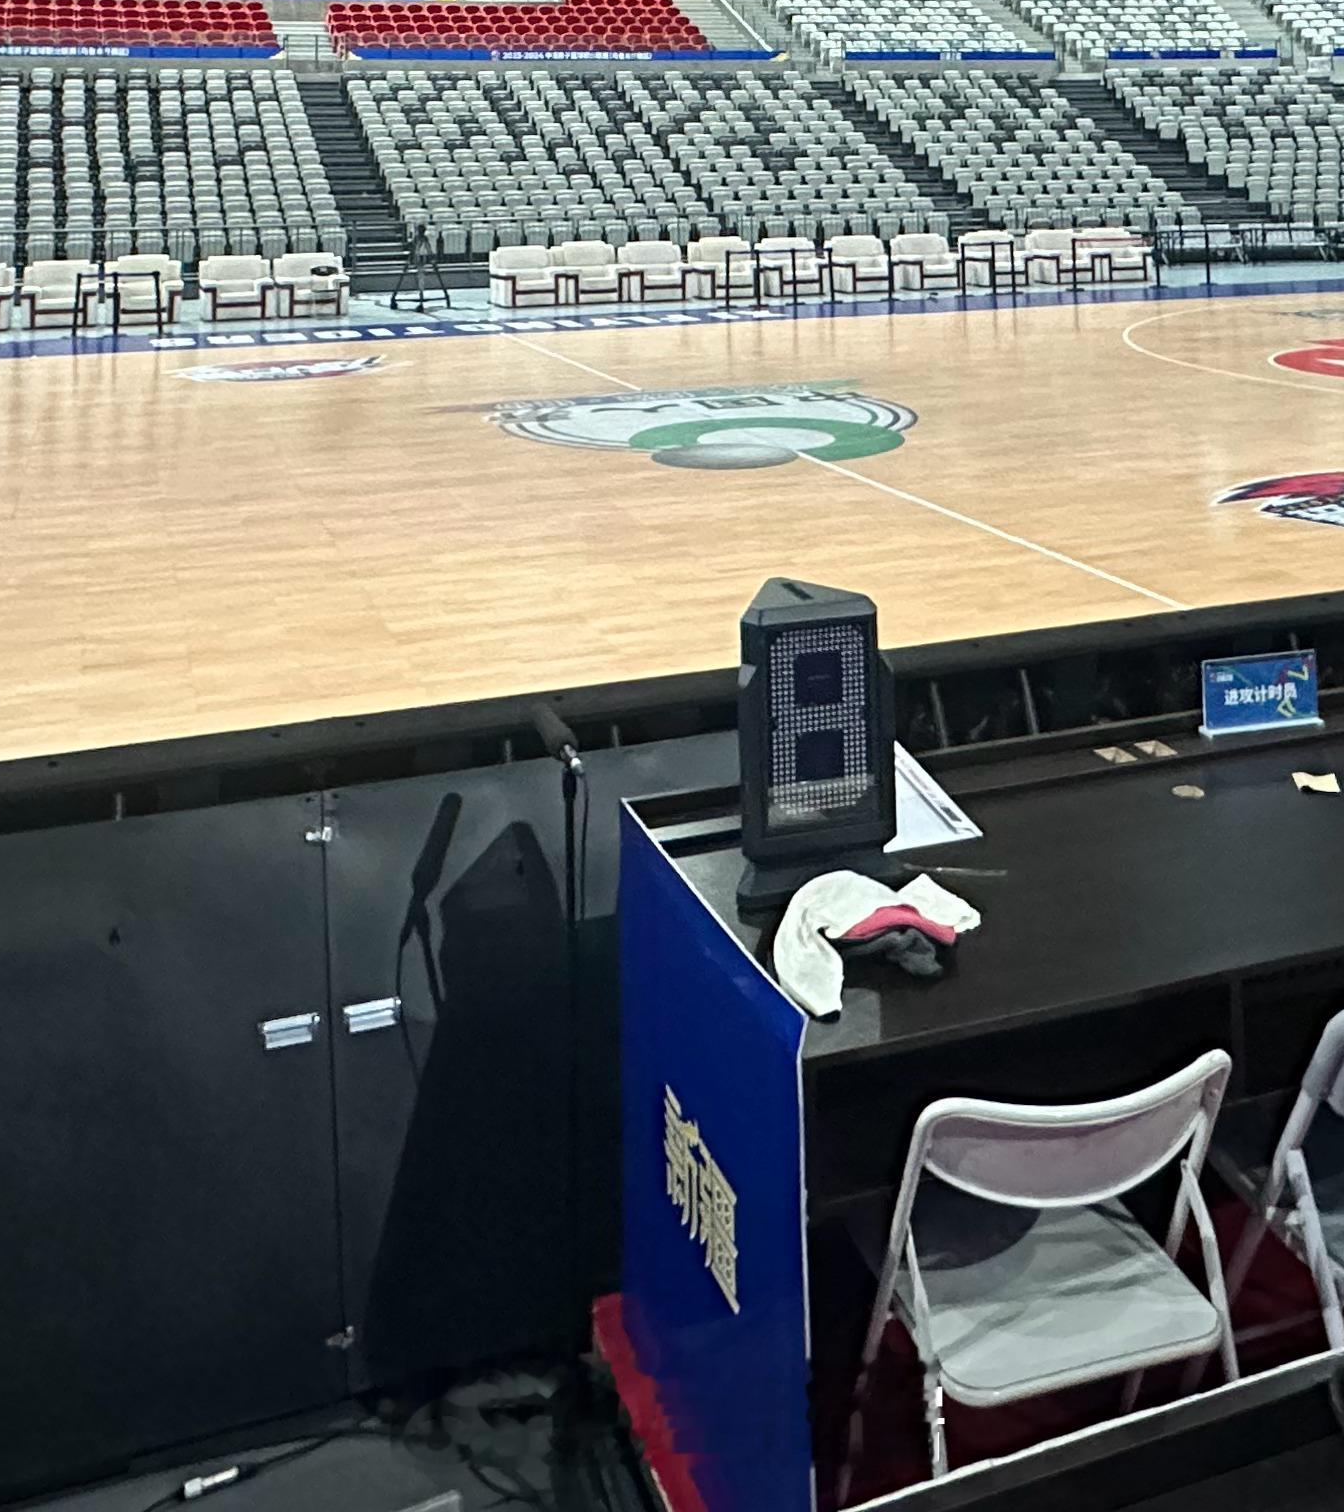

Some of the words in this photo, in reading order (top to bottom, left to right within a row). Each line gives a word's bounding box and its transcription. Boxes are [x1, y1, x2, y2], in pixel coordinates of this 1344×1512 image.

[1224, 681, 1298, 706] 进攻计时员
